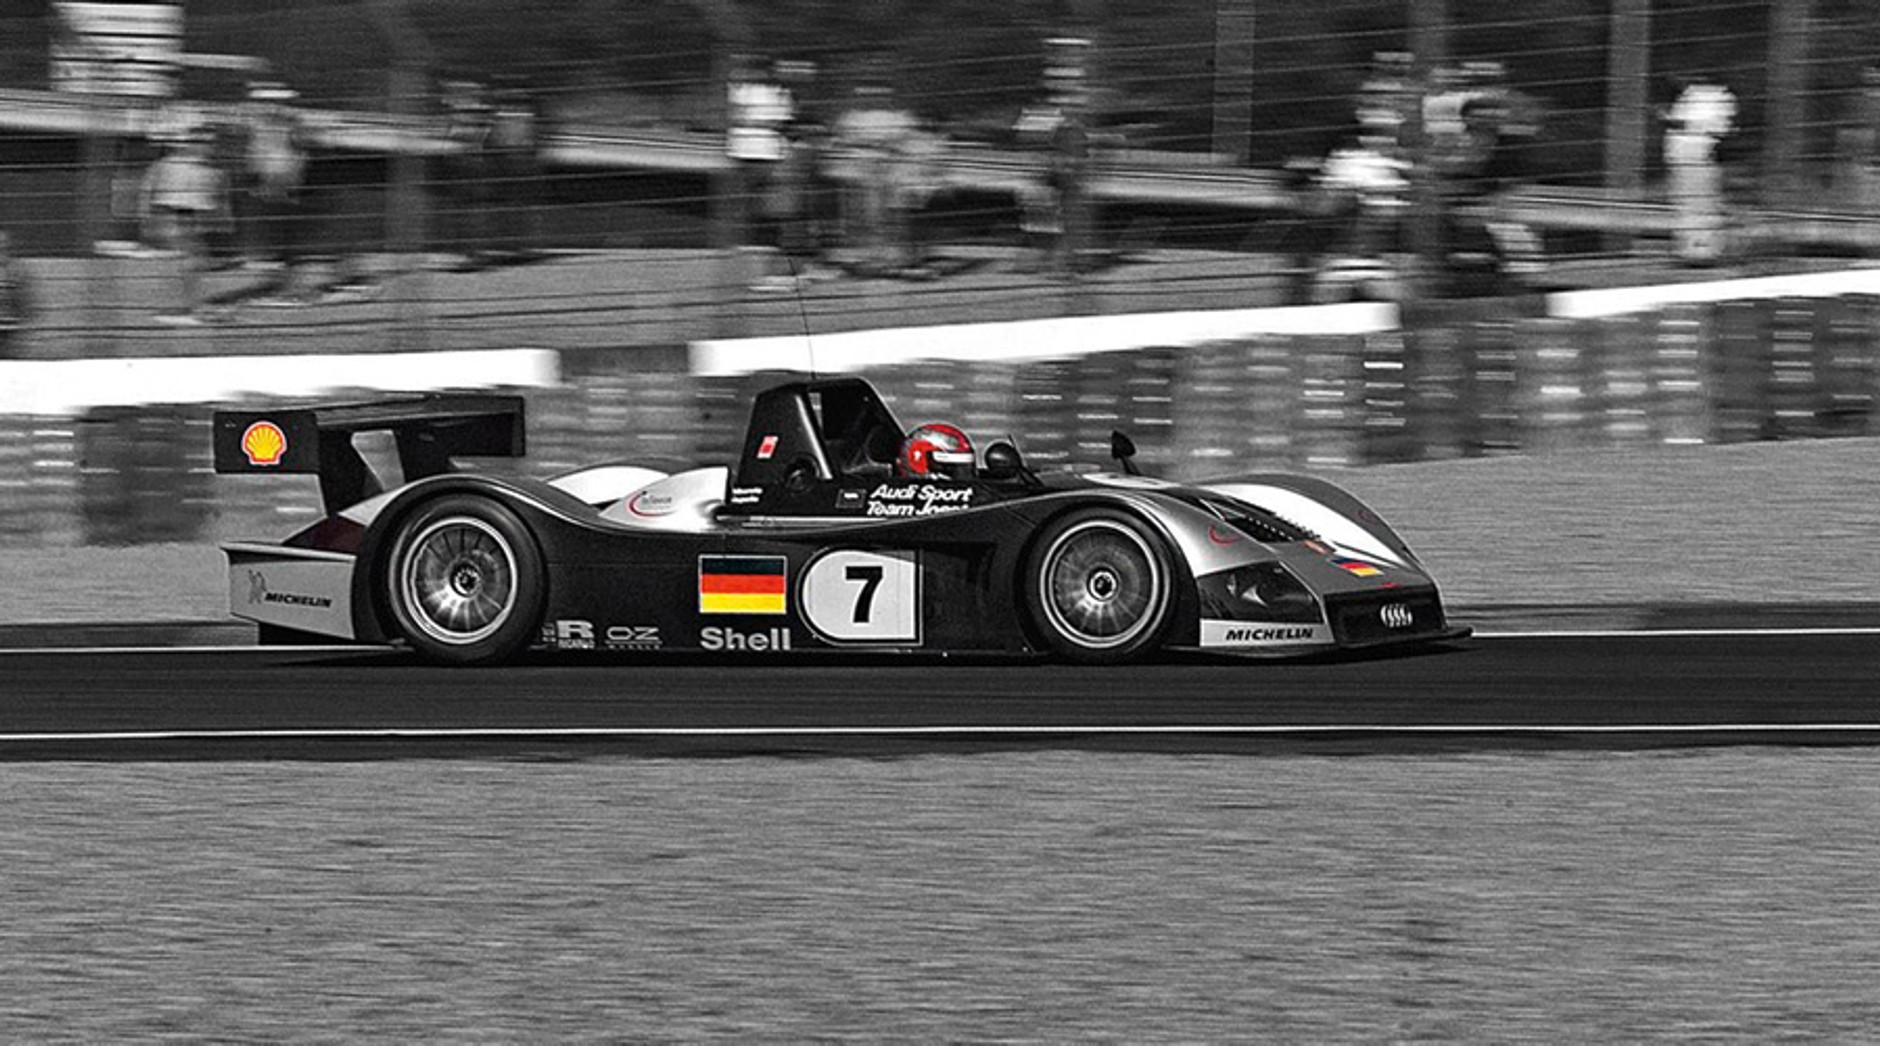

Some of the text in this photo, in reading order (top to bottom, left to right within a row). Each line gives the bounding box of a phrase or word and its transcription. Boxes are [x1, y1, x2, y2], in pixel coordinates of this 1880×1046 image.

[869, 483, 918, 499] Audi
[917, 484, 973, 502] Sport
[866, 500, 915, 516] Team
[265, 592, 332, 608] MICHELIN
[846, 566, 884, 623] 7
[701, 626, 791, 651] Shell
[1226, 628, 1313, 640] MICHELIN
